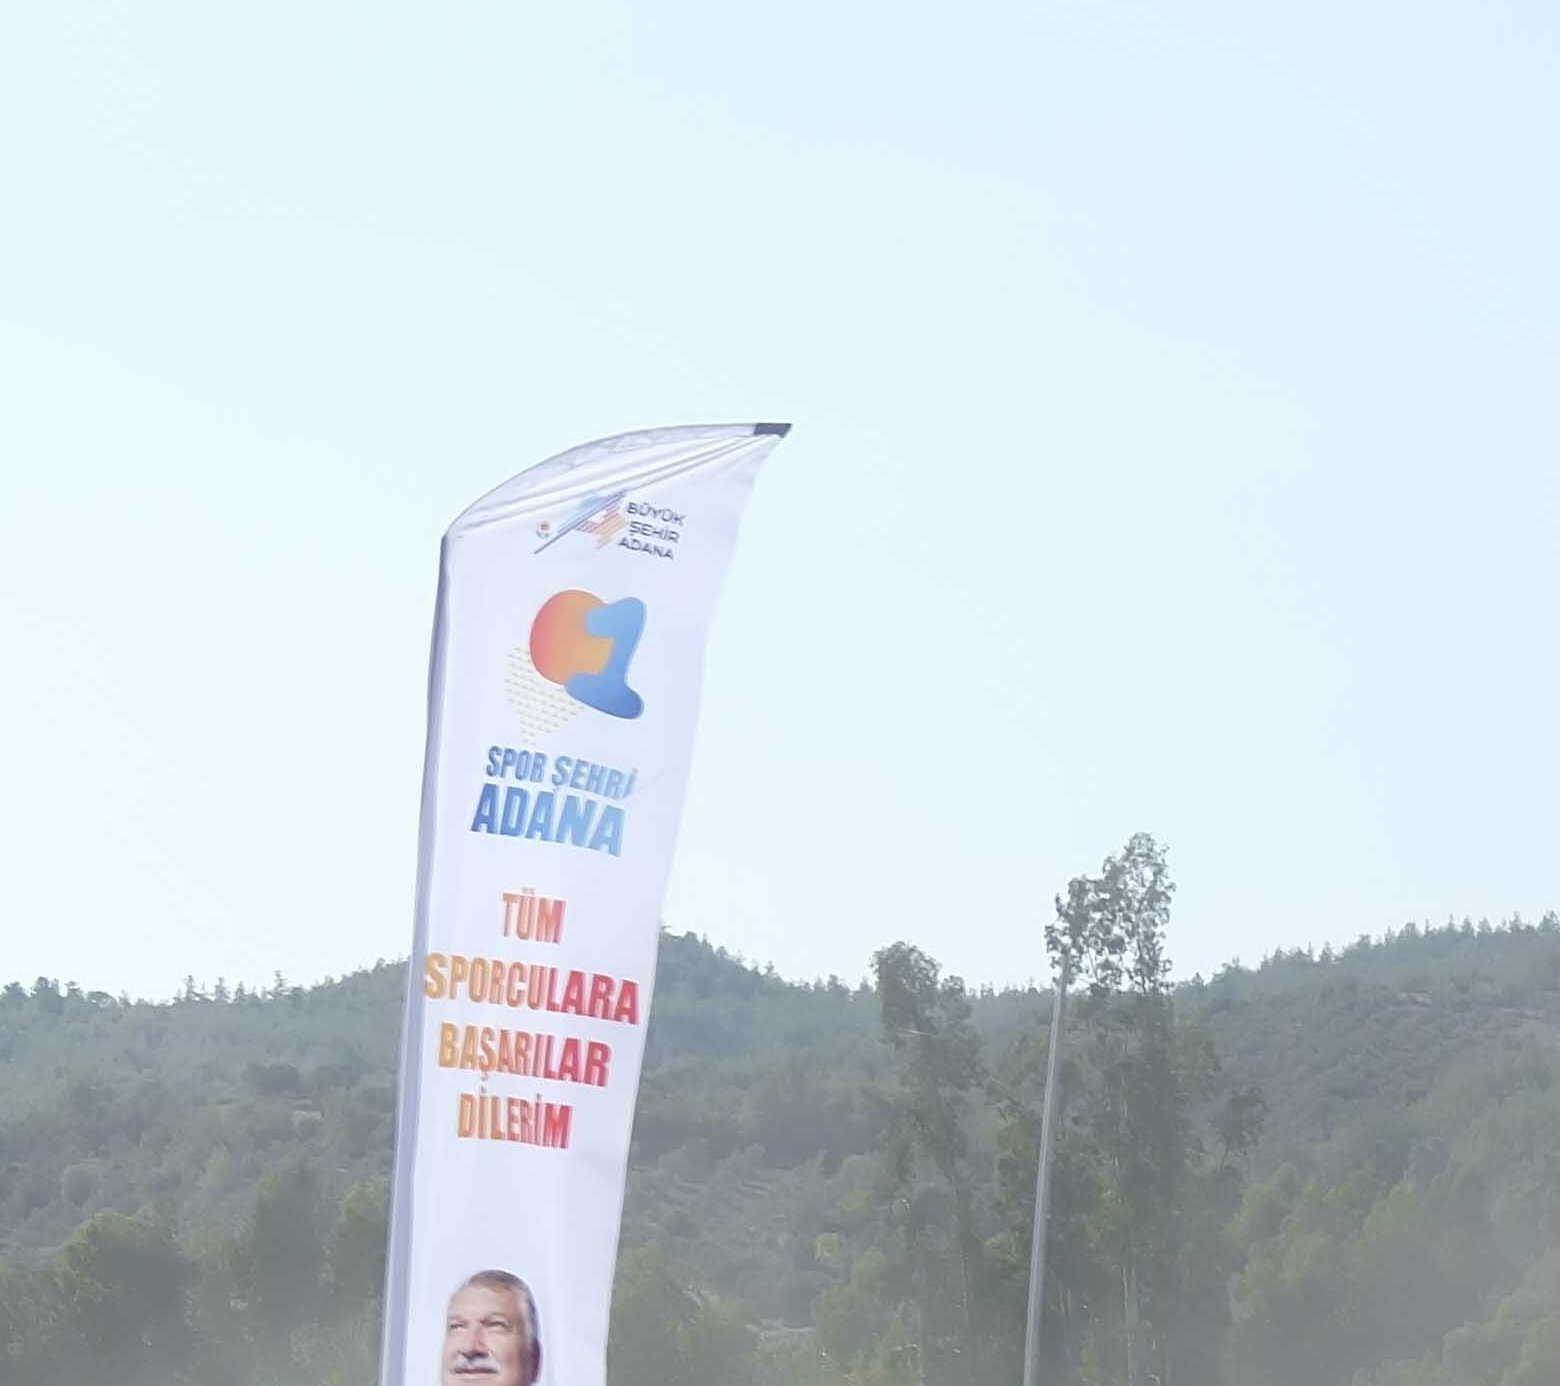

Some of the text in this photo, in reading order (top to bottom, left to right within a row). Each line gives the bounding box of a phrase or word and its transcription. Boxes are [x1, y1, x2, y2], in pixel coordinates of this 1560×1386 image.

[627, 501, 686, 526] BÜYÜK
[619, 537, 675, 560] ADANA
[486, 745, 548, 783] SPOR
[470, 782, 626, 858] ADANA
[502, 886, 567, 945] TÜM
[424, 952, 640, 1025] SPORCULARA
[438, 1022, 613, 1088] BAŞARILAR
[456, 1086, 573, 1150] DİLERİM
